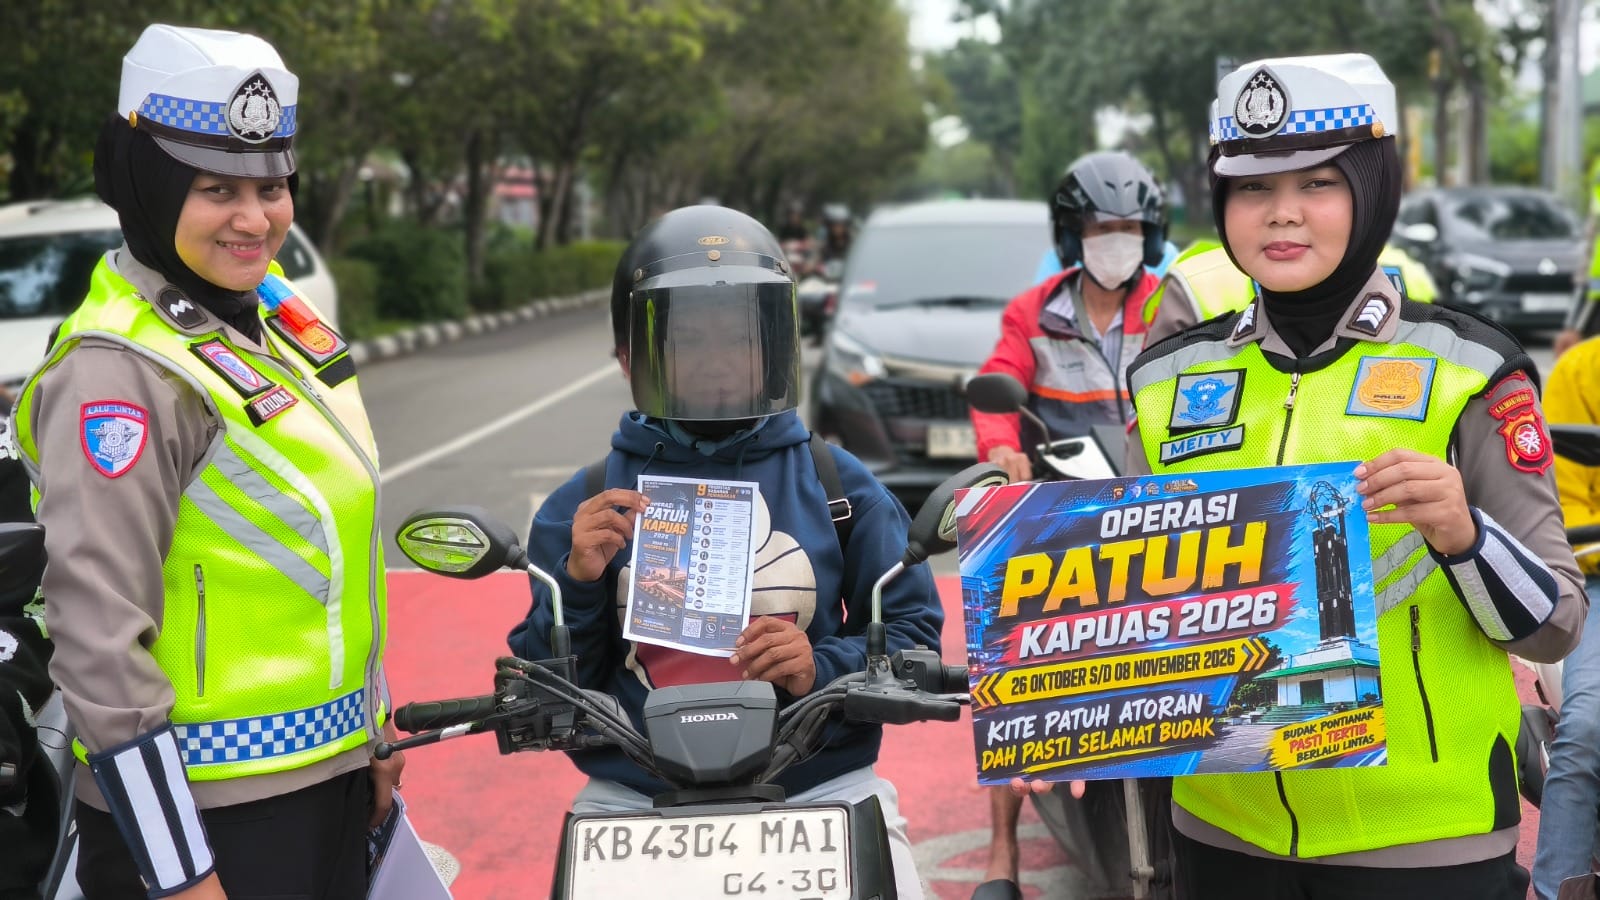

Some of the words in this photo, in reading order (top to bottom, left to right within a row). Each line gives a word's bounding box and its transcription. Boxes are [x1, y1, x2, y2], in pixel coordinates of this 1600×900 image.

[86, 405, 108, 415] LALU
[115, 406, 143, 418] LINTAS
[1170, 430, 1232, 456] MEITY
[697, 484, 707, 496] 9
[642, 519, 689, 535] KAPUAS
[644, 507, 689, 523] PATUH
[1100, 493, 1238, 539] OPERASI
[999, 520, 1267, 618] PATUH
[1019, 606, 1170, 659] KAPUAS
[1179, 591, 1278, 636] 2026
[1011, 676, 1026, 696] 26
[1030, 670, 1086, 694] OKTOBER
[1089, 666, 1111, 686] S/D
[1114, 663, 1130, 681] 08
[1134, 654, 1200, 678] NOVEMBER
[1204, 648, 1235, 669] 2026
[680, 712, 739, 724] HONDA
[987, 714, 1037, 747] KITE
[1045, 703, 1109, 734] PATUH
[1119, 693, 1203, 725] ATORAN
[1283, 724, 1317, 741] BUDAK
[1320, 710, 1374, 731] PONTIANAK
[981, 746, 1017, 771] DAH
[1021, 736, 1071, 764] PASTI
[1078, 724, 1156, 755] SELAMAT
[1159, 717, 1216, 743] BUDAK
[1289, 734, 1322, 753] PASTI
[1326, 723, 1367, 743] TERTIB
[1297, 744, 1340, 762] BERLALU
[1343, 734, 1375, 750] LINTAS
[583, 825, 632, 861] KB
[641, 823, 738, 860] 4304
[761, 818, 837, 854] MAI
